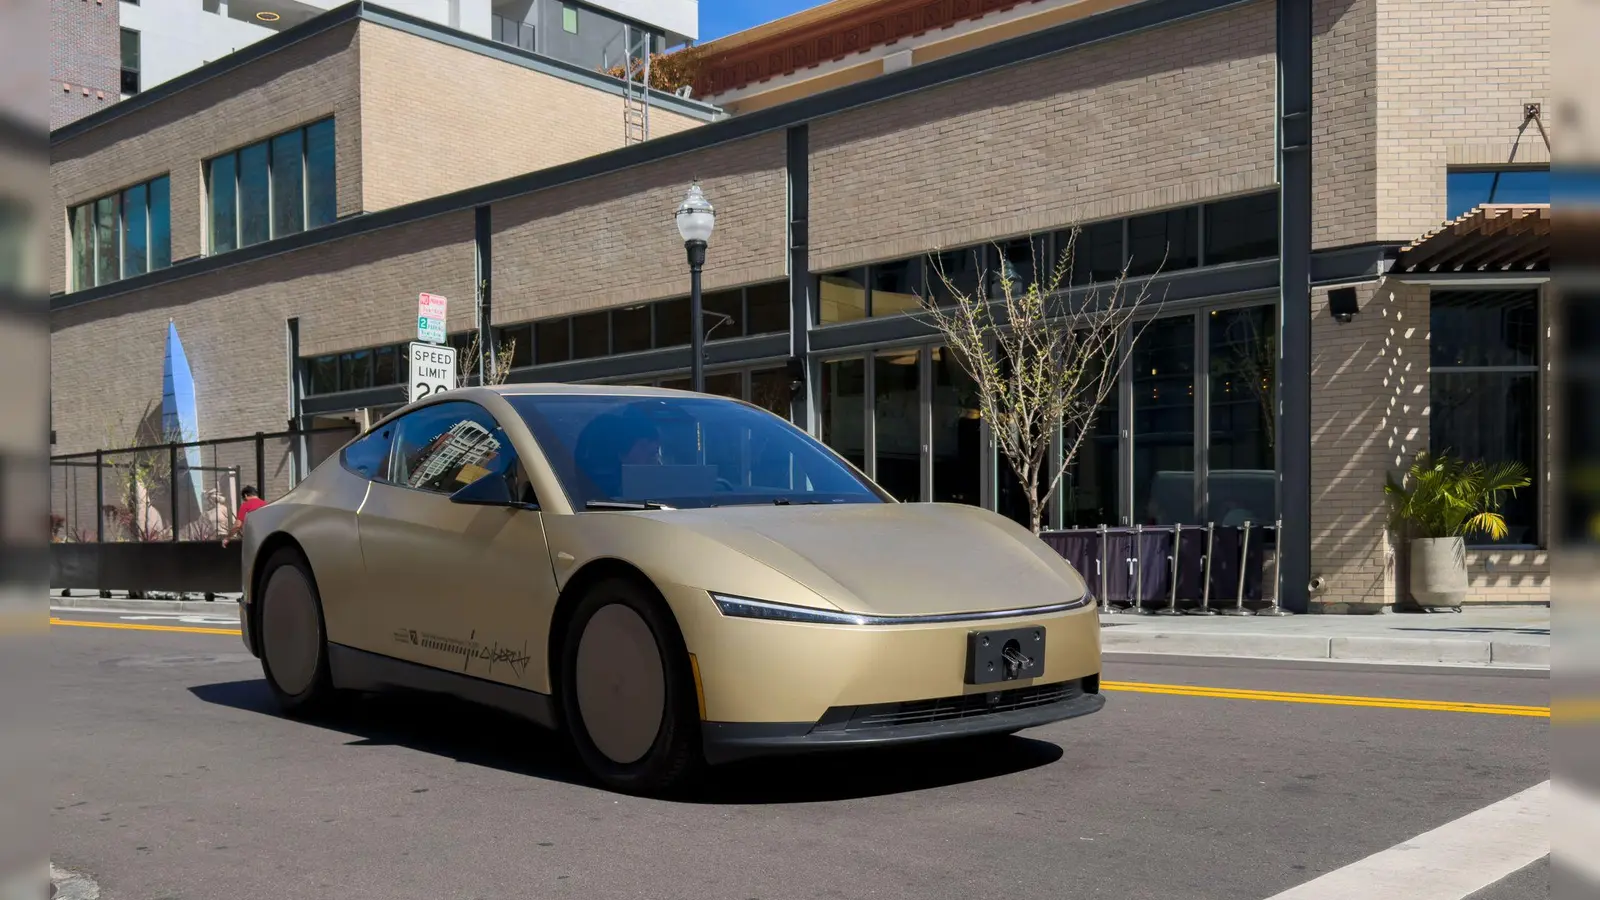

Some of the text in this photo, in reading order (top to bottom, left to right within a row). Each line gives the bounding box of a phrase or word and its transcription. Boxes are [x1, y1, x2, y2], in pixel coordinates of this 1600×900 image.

[420, 318, 426, 328] 2
[415, 350, 451, 365] SPEED
[418, 366, 447, 379] LIMIT
